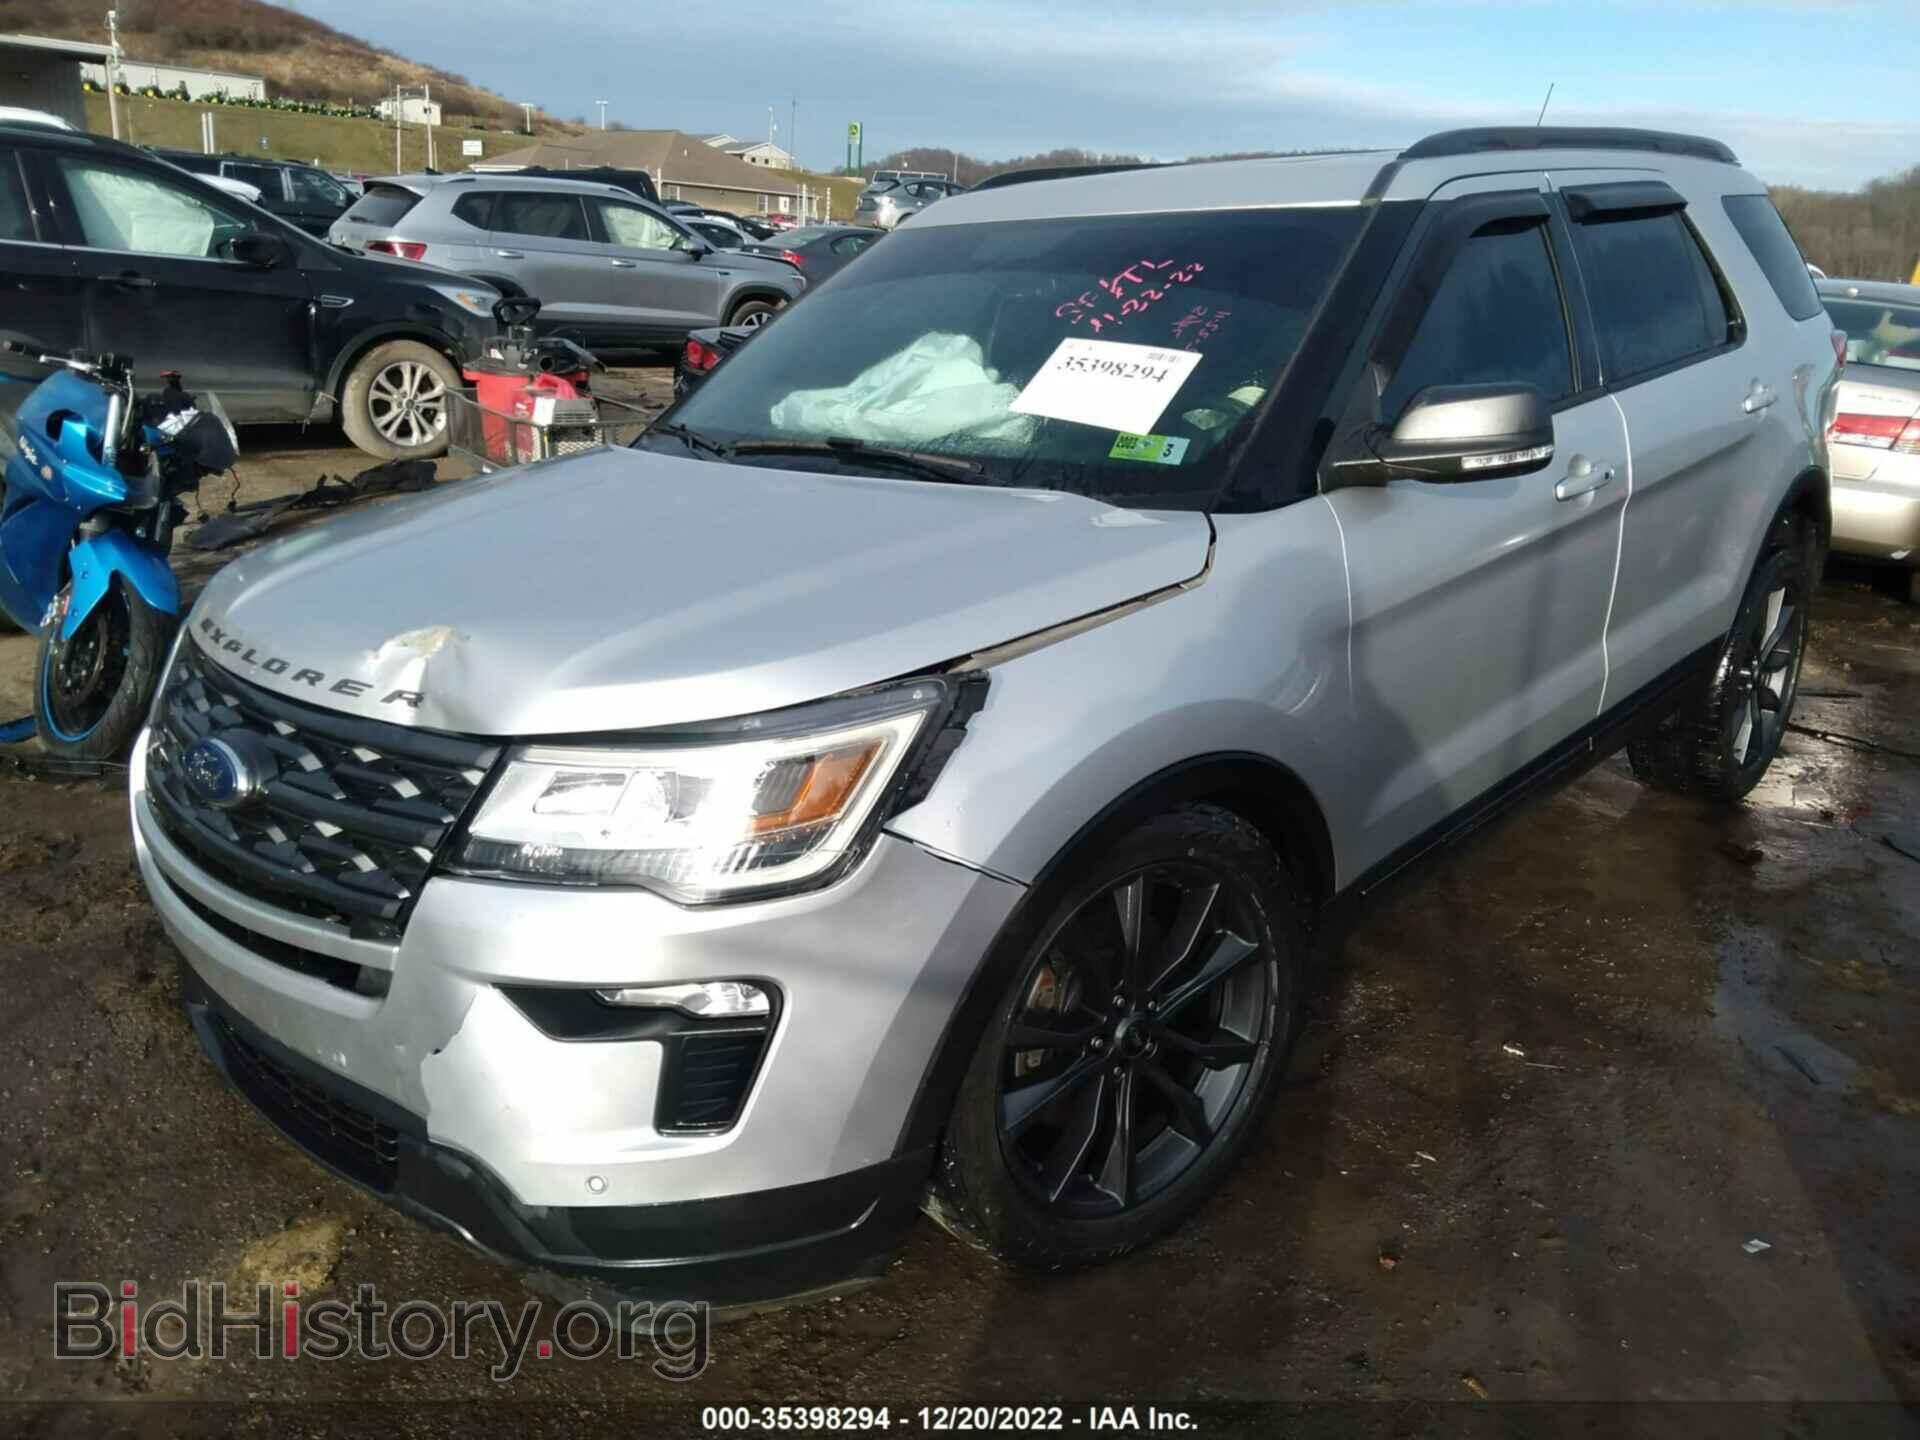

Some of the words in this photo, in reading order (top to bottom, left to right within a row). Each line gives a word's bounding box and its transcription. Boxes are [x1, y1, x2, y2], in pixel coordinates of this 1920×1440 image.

[1056, 355, 1169, 383] 35398294
[1163, 443, 1174, 458] 3
[201, 616, 425, 708] EXPLORER
